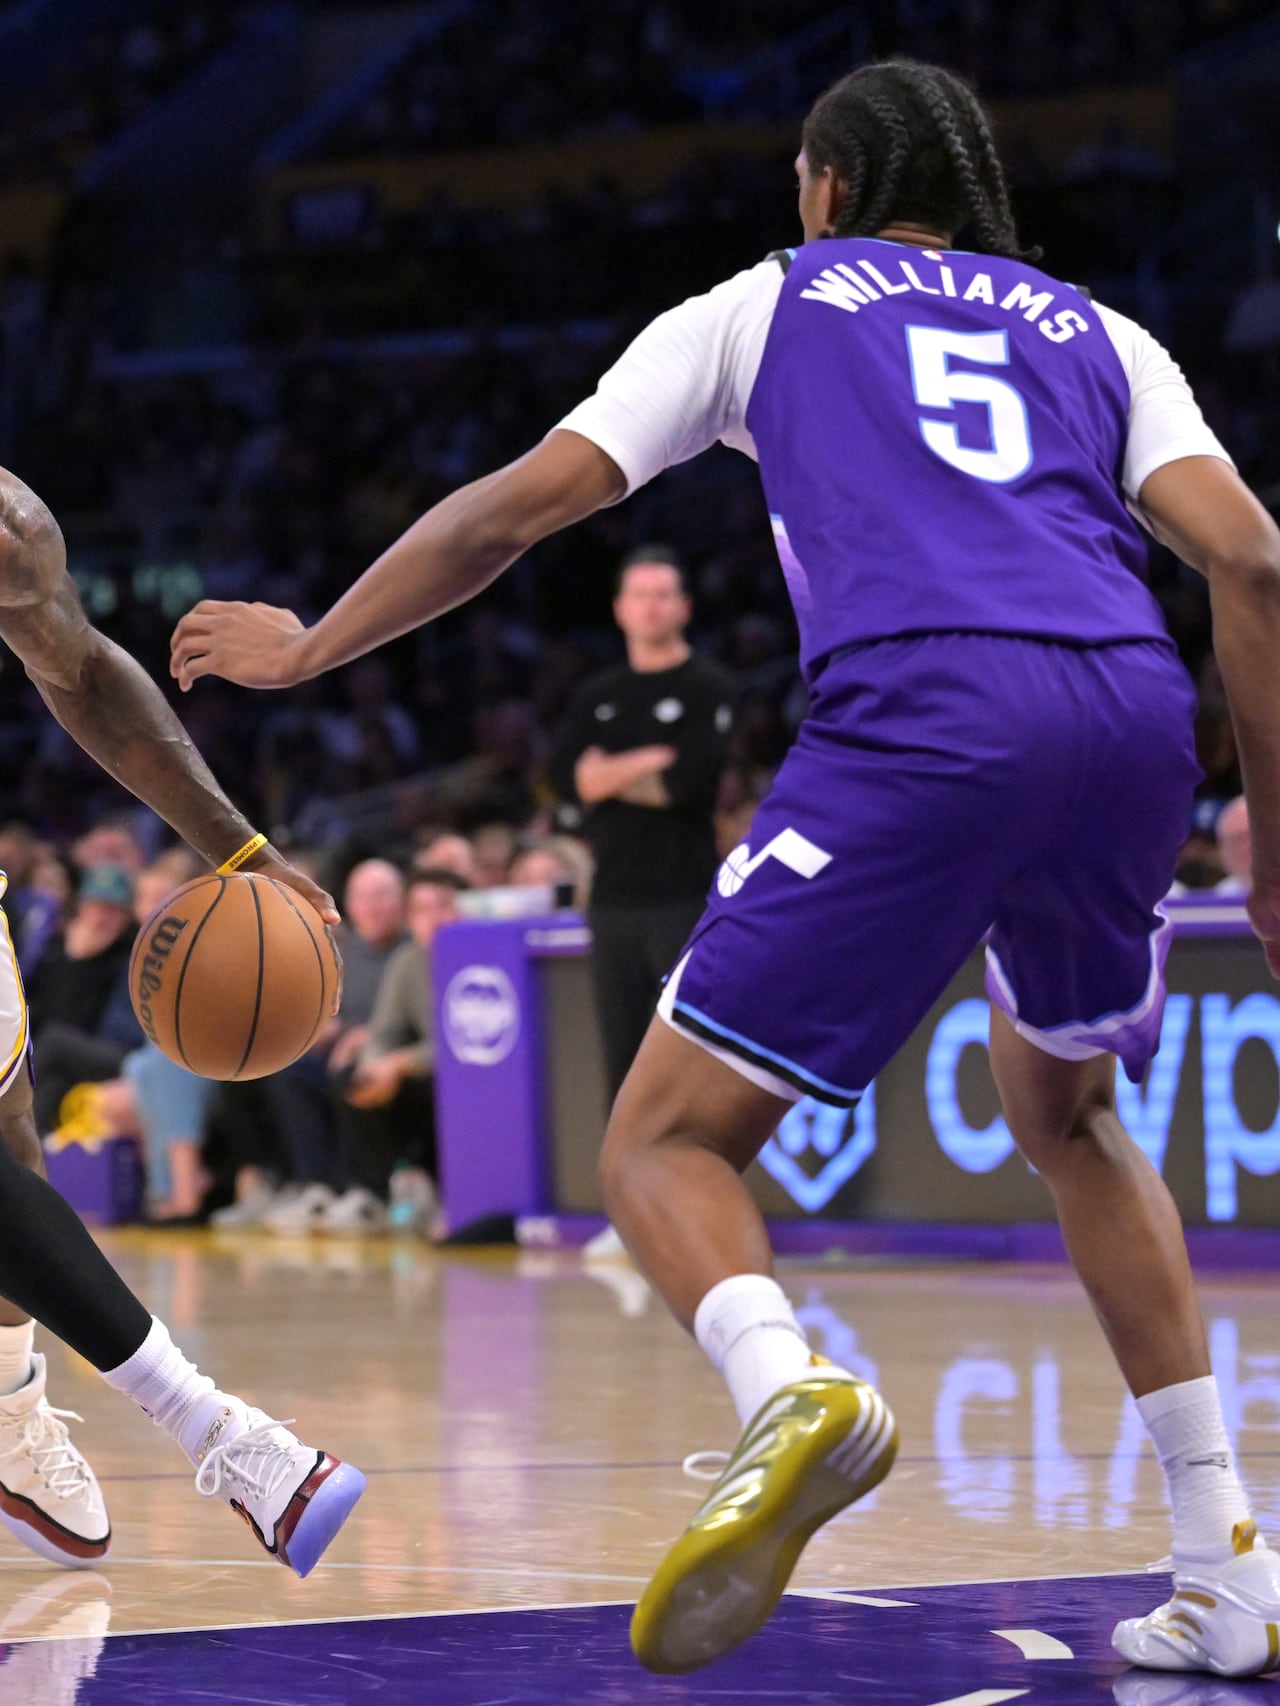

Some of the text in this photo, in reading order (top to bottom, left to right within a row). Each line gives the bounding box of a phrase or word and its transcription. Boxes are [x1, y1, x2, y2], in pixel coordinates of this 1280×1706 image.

[800, 259, 1089, 344] WILLIAMS
[905, 323, 1034, 485] 5
[229, 841, 258, 868] PROMISE
